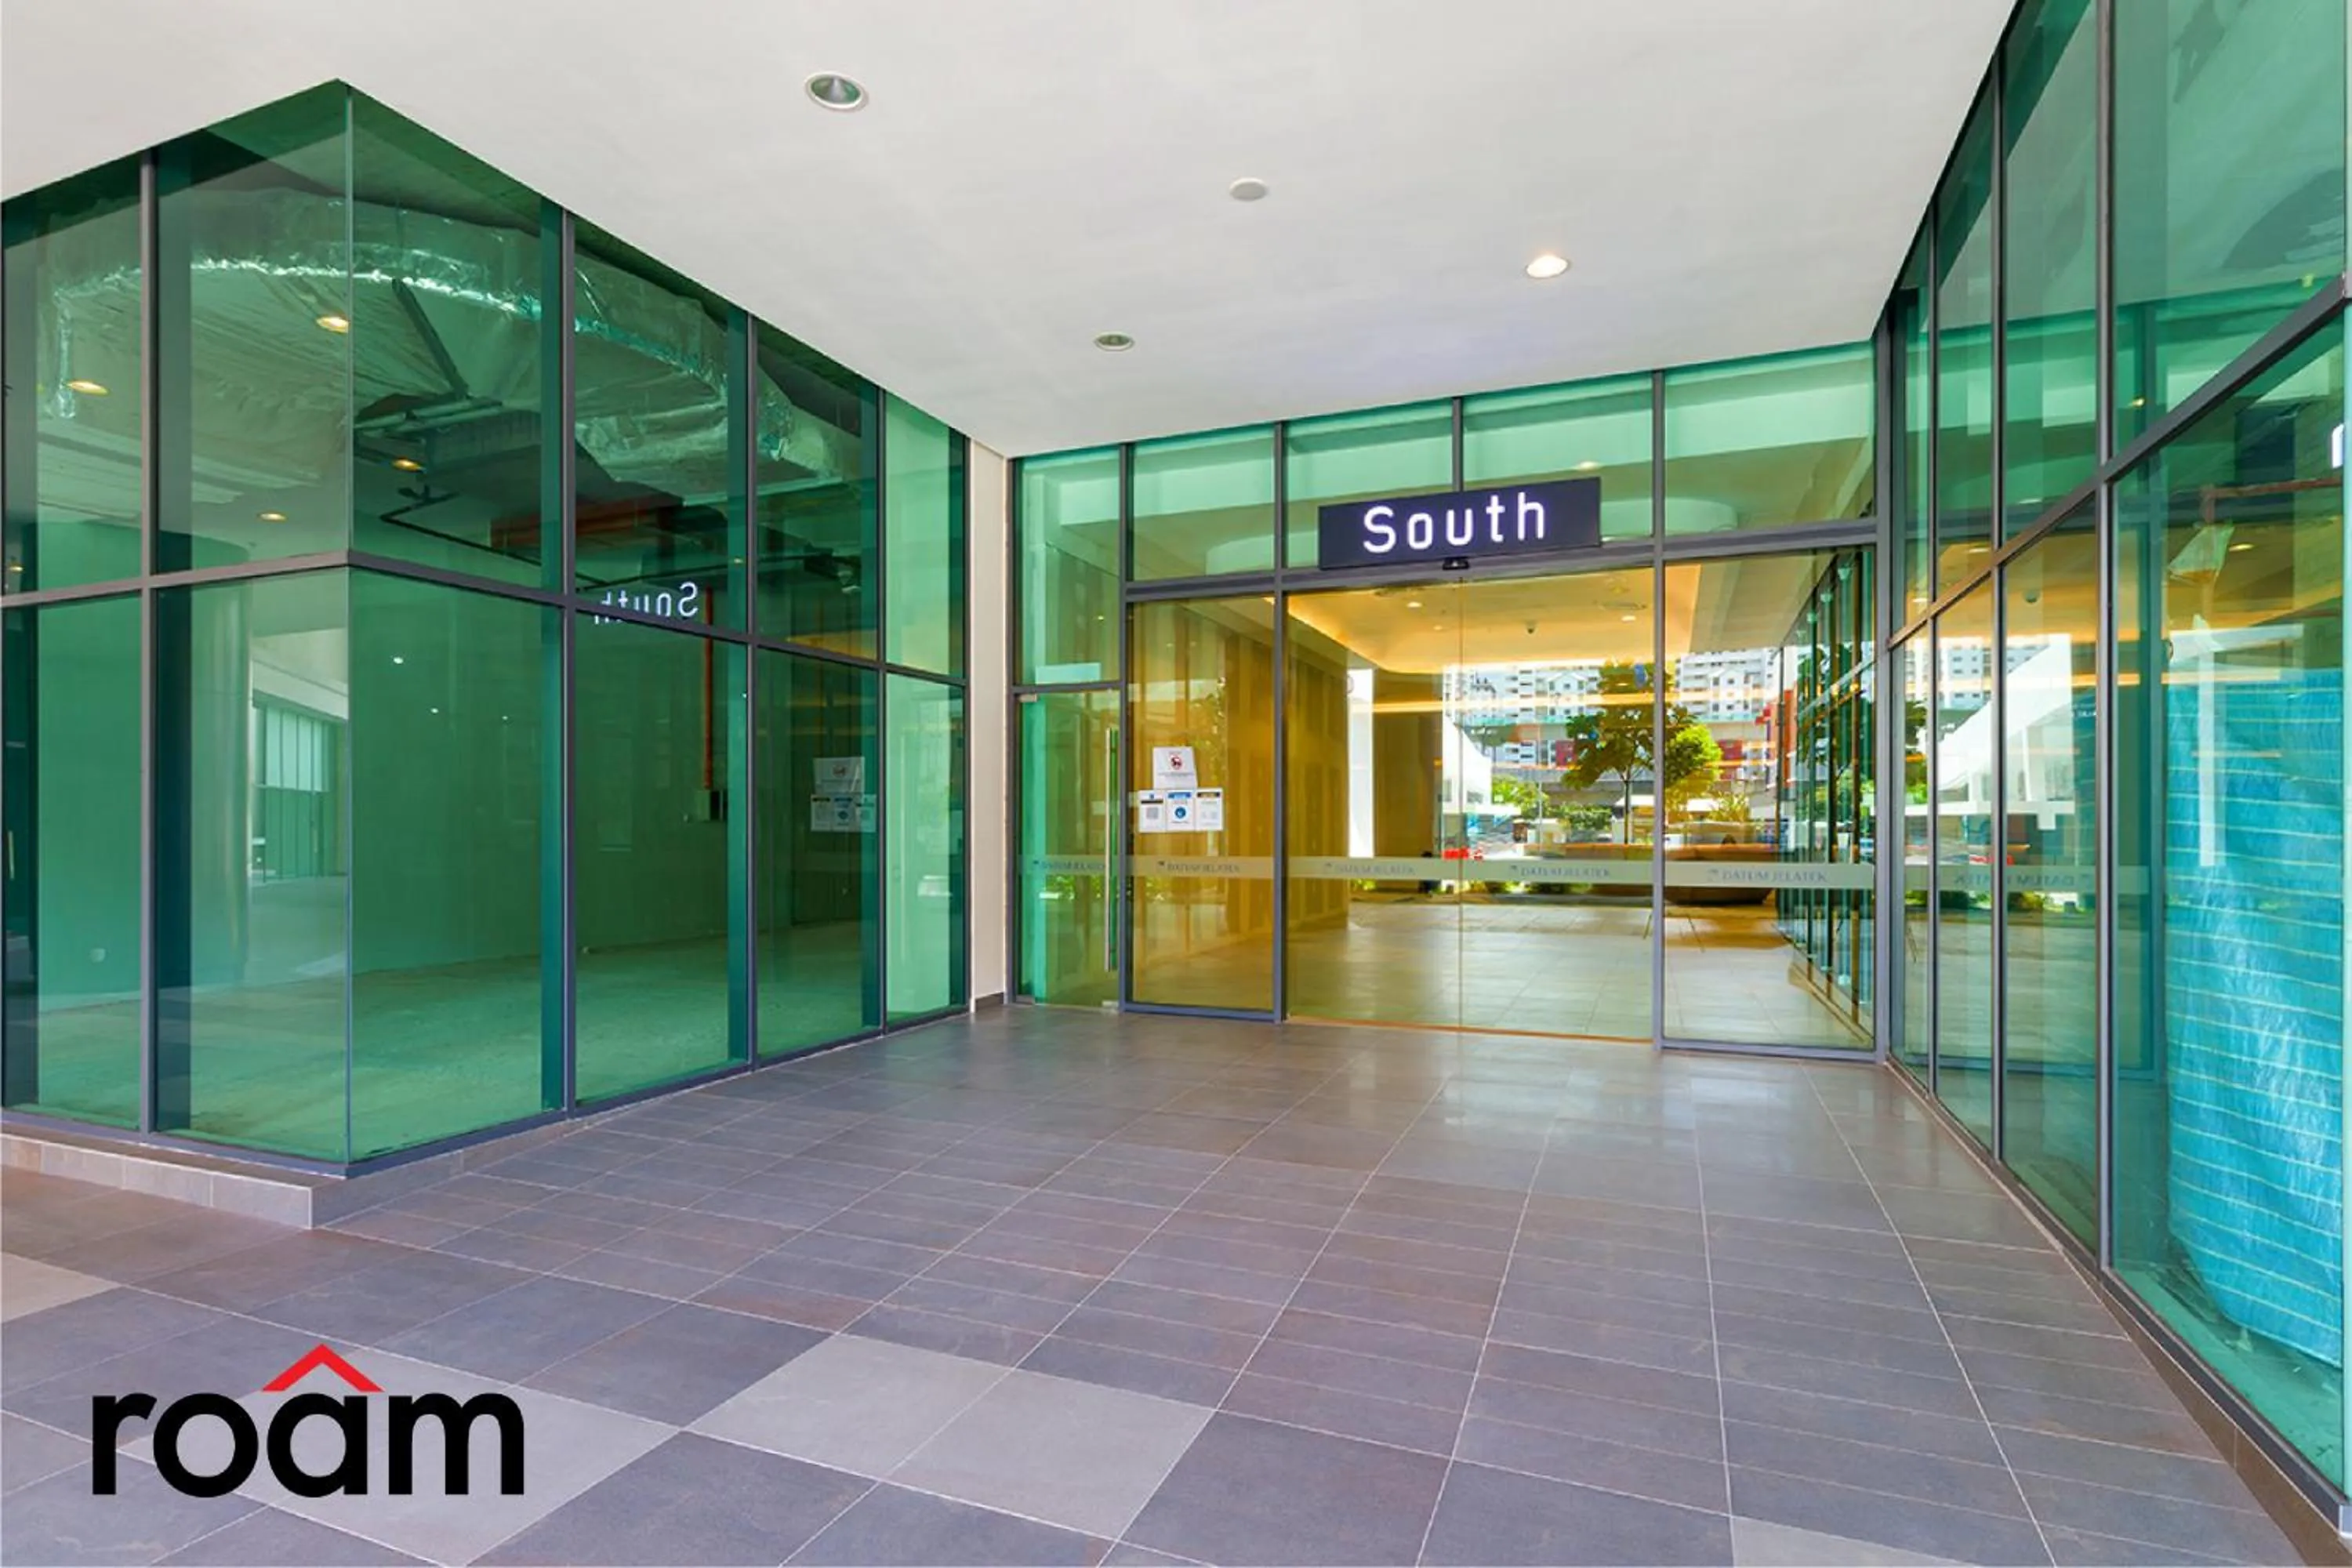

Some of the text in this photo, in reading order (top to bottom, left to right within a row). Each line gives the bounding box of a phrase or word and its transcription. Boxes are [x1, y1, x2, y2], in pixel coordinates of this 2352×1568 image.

[1363, 492, 1545, 554] South
[1721, 868, 1828, 884] DATUM JELATEK
